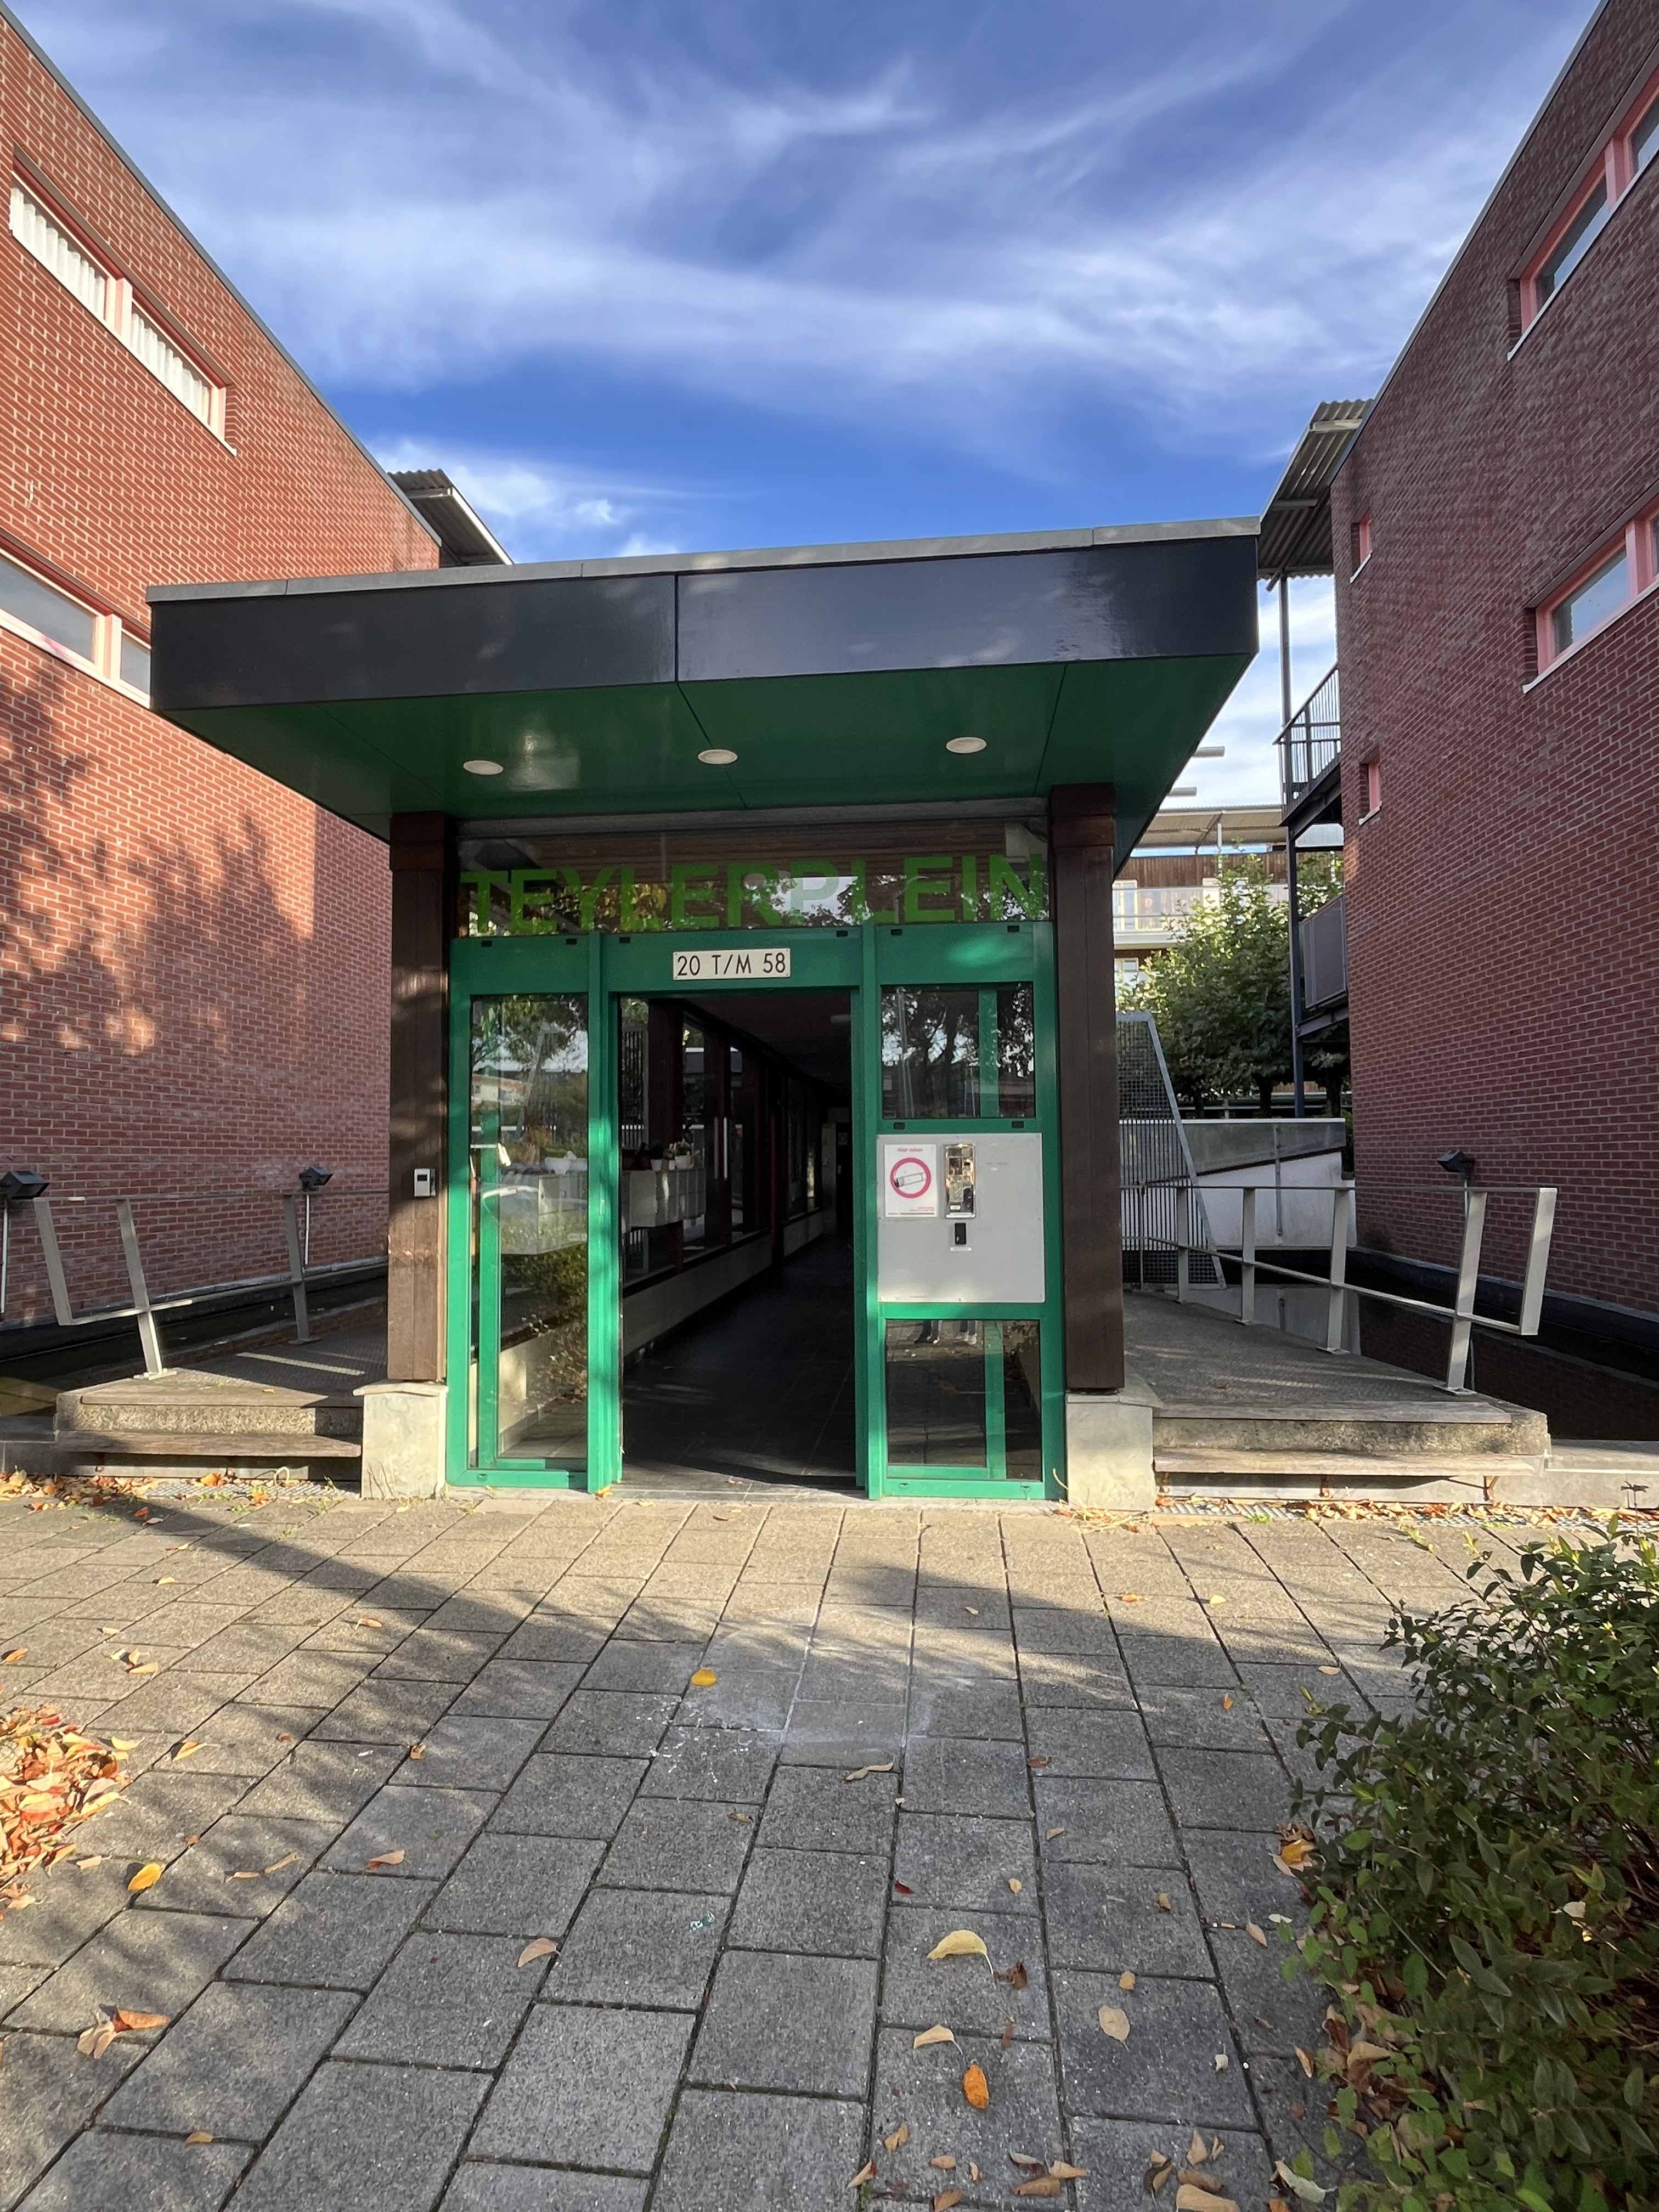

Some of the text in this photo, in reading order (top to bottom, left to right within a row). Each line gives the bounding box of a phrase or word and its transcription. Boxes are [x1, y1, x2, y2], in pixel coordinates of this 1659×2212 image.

[460, 854, 1045, 934] TEYLERPLEIN
[677, 952, 786, 976] 20 T/M 58
